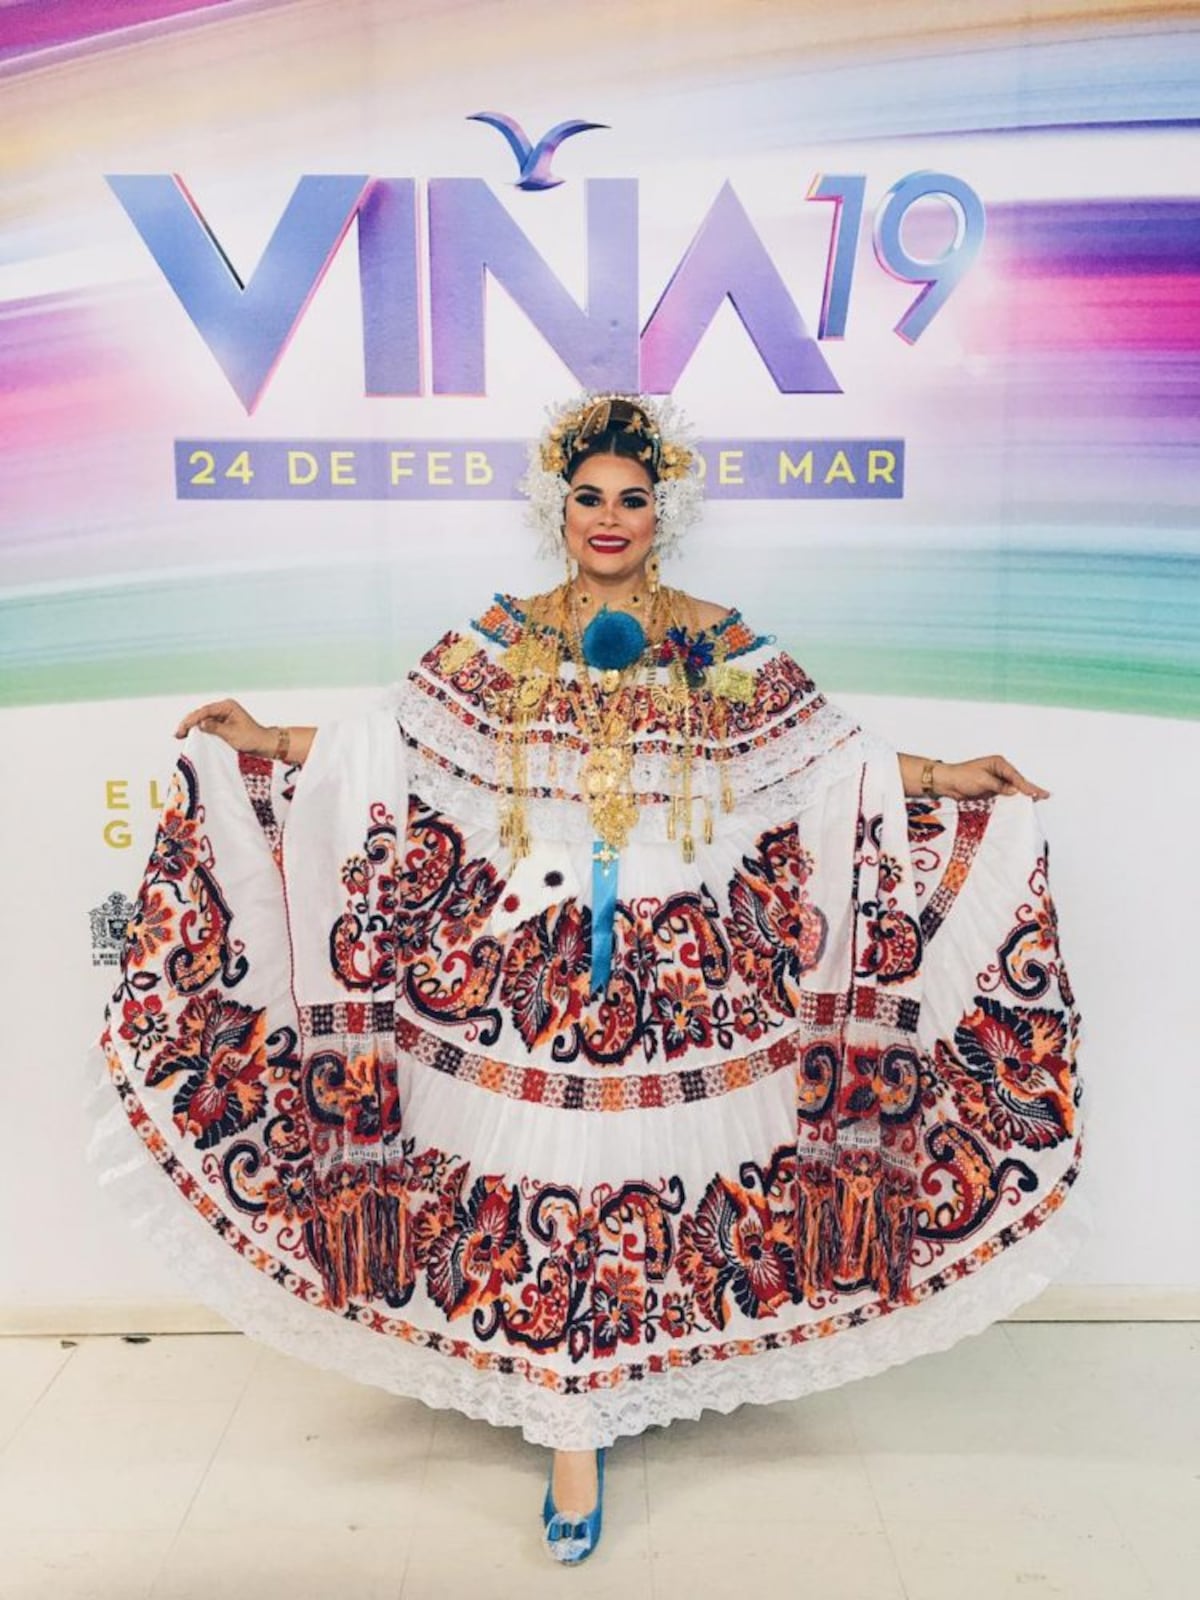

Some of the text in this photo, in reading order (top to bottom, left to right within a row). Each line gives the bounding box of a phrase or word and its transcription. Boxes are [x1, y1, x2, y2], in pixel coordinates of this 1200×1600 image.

[805, 169, 986, 346] 19
[189, 450, 495, 486] 24 DE FEB
[778, 449, 897, 485] MAR
